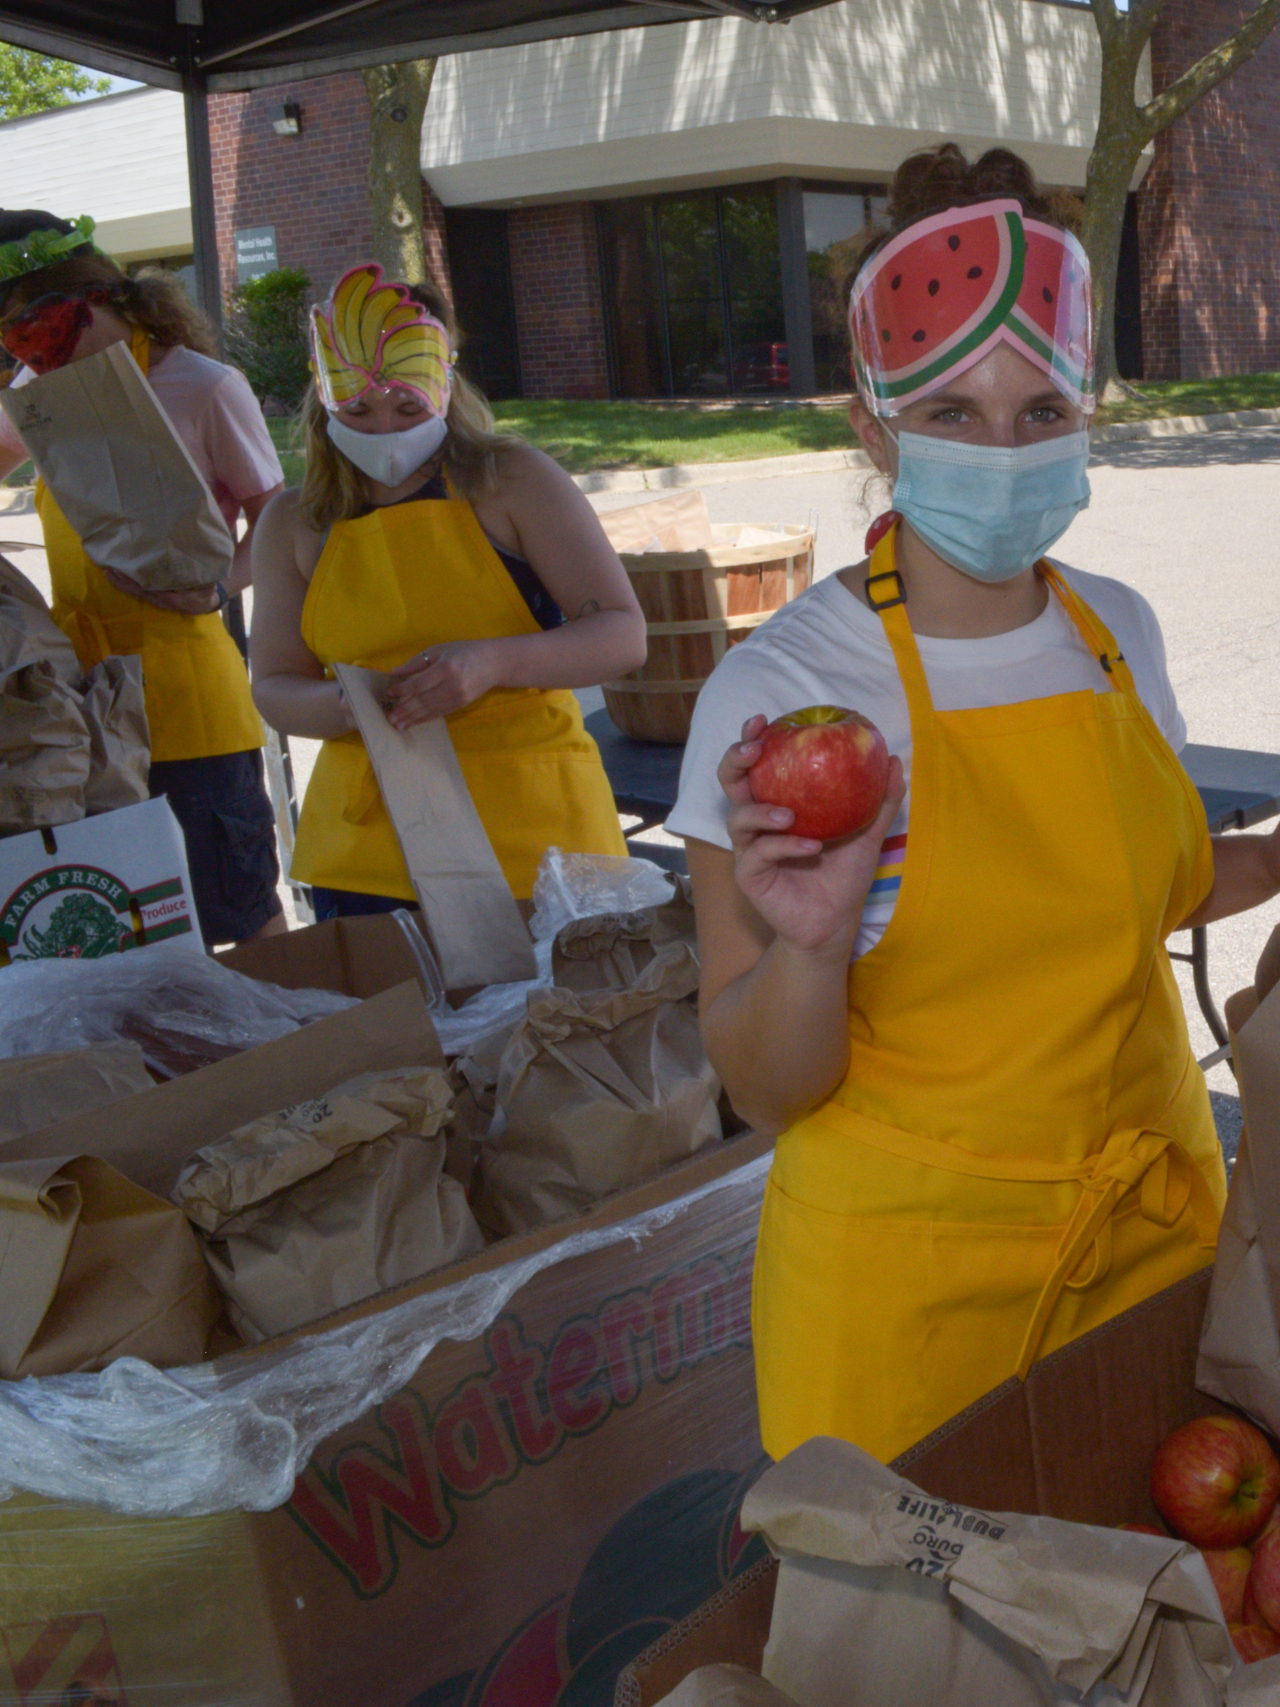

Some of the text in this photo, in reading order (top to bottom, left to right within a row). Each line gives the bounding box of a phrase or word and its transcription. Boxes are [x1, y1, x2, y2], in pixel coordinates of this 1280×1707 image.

[238, 236, 272, 249] Mental Health
[4, 871, 122, 927] FARM FRESH
[141, 900, 187, 920] Produce
[313, 1103, 333, 1123] 20
[897, 1495, 1006, 1541] DUBL LIFE
[911, 1531, 964, 1556] DURO
